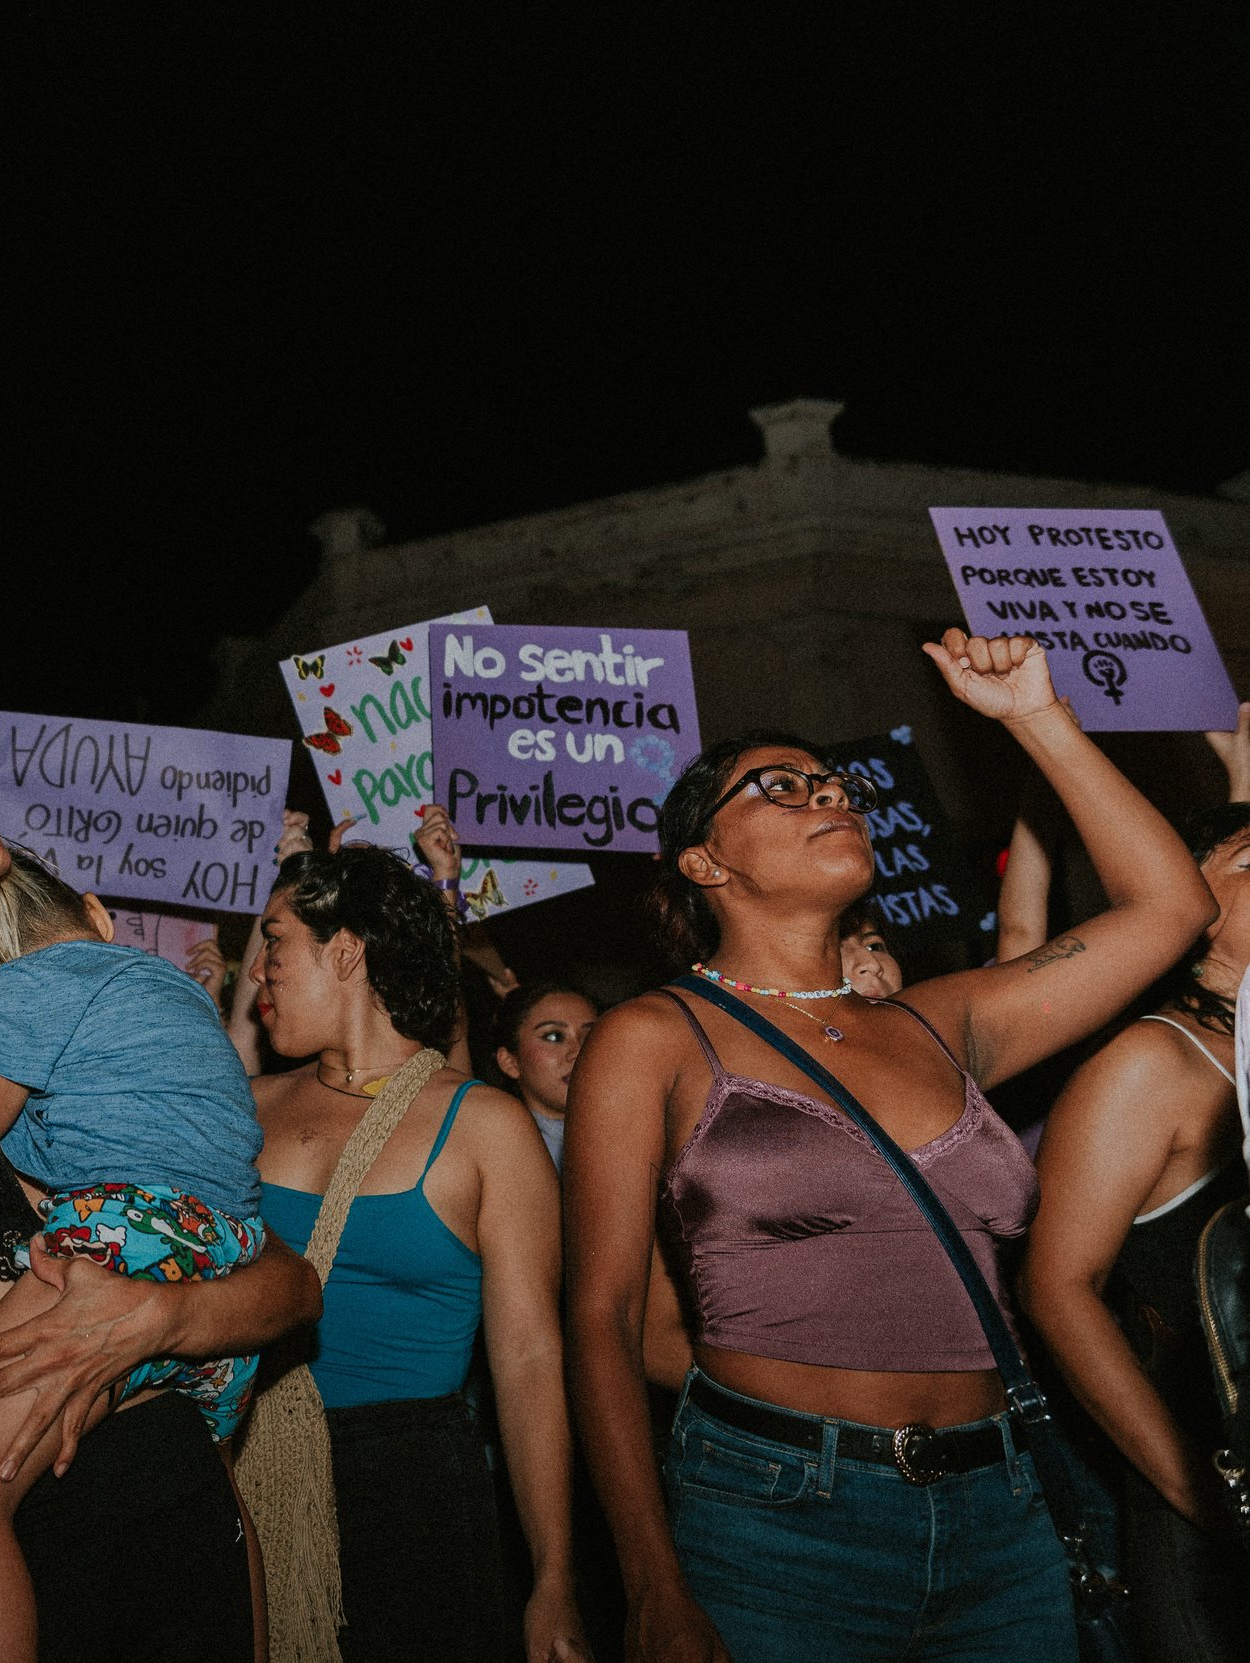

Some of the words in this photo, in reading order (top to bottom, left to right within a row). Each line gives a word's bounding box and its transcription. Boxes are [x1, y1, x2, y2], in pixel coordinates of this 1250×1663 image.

[953, 524, 1011, 549] HOY
[1026, 524, 1165, 551] PROTESTO
[960, 564, 1067, 588] PORQUE
[1070, 566, 1157, 589] ESTOY
[986, 600, 1060, 623] VIVA
[1062, 600, 1080, 620] Y
[1084, 600, 1128, 621] NO
[1130, 601, 1174, 626] SE
[443, 633, 506, 679] No
[1000, 630, 1090, 652] STA
[1093, 631, 1192, 654] CUANDO
[441, 682, 681, 735] impotencia
[11, 722, 151, 797] AYUDA
[507, 728, 557, 761] es
[565, 731, 626, 764] un
[160, 764, 272, 808] pidiendo
[17, 803, 123, 845] GRITÓ
[136, 803, 219, 843] quien
[449, 768, 661, 847] Privilegio
[229, 818, 266, 854] de
[75, 853, 104, 886] la
[118, 842, 167, 880] soy
[181, 860, 260, 906] HOY
